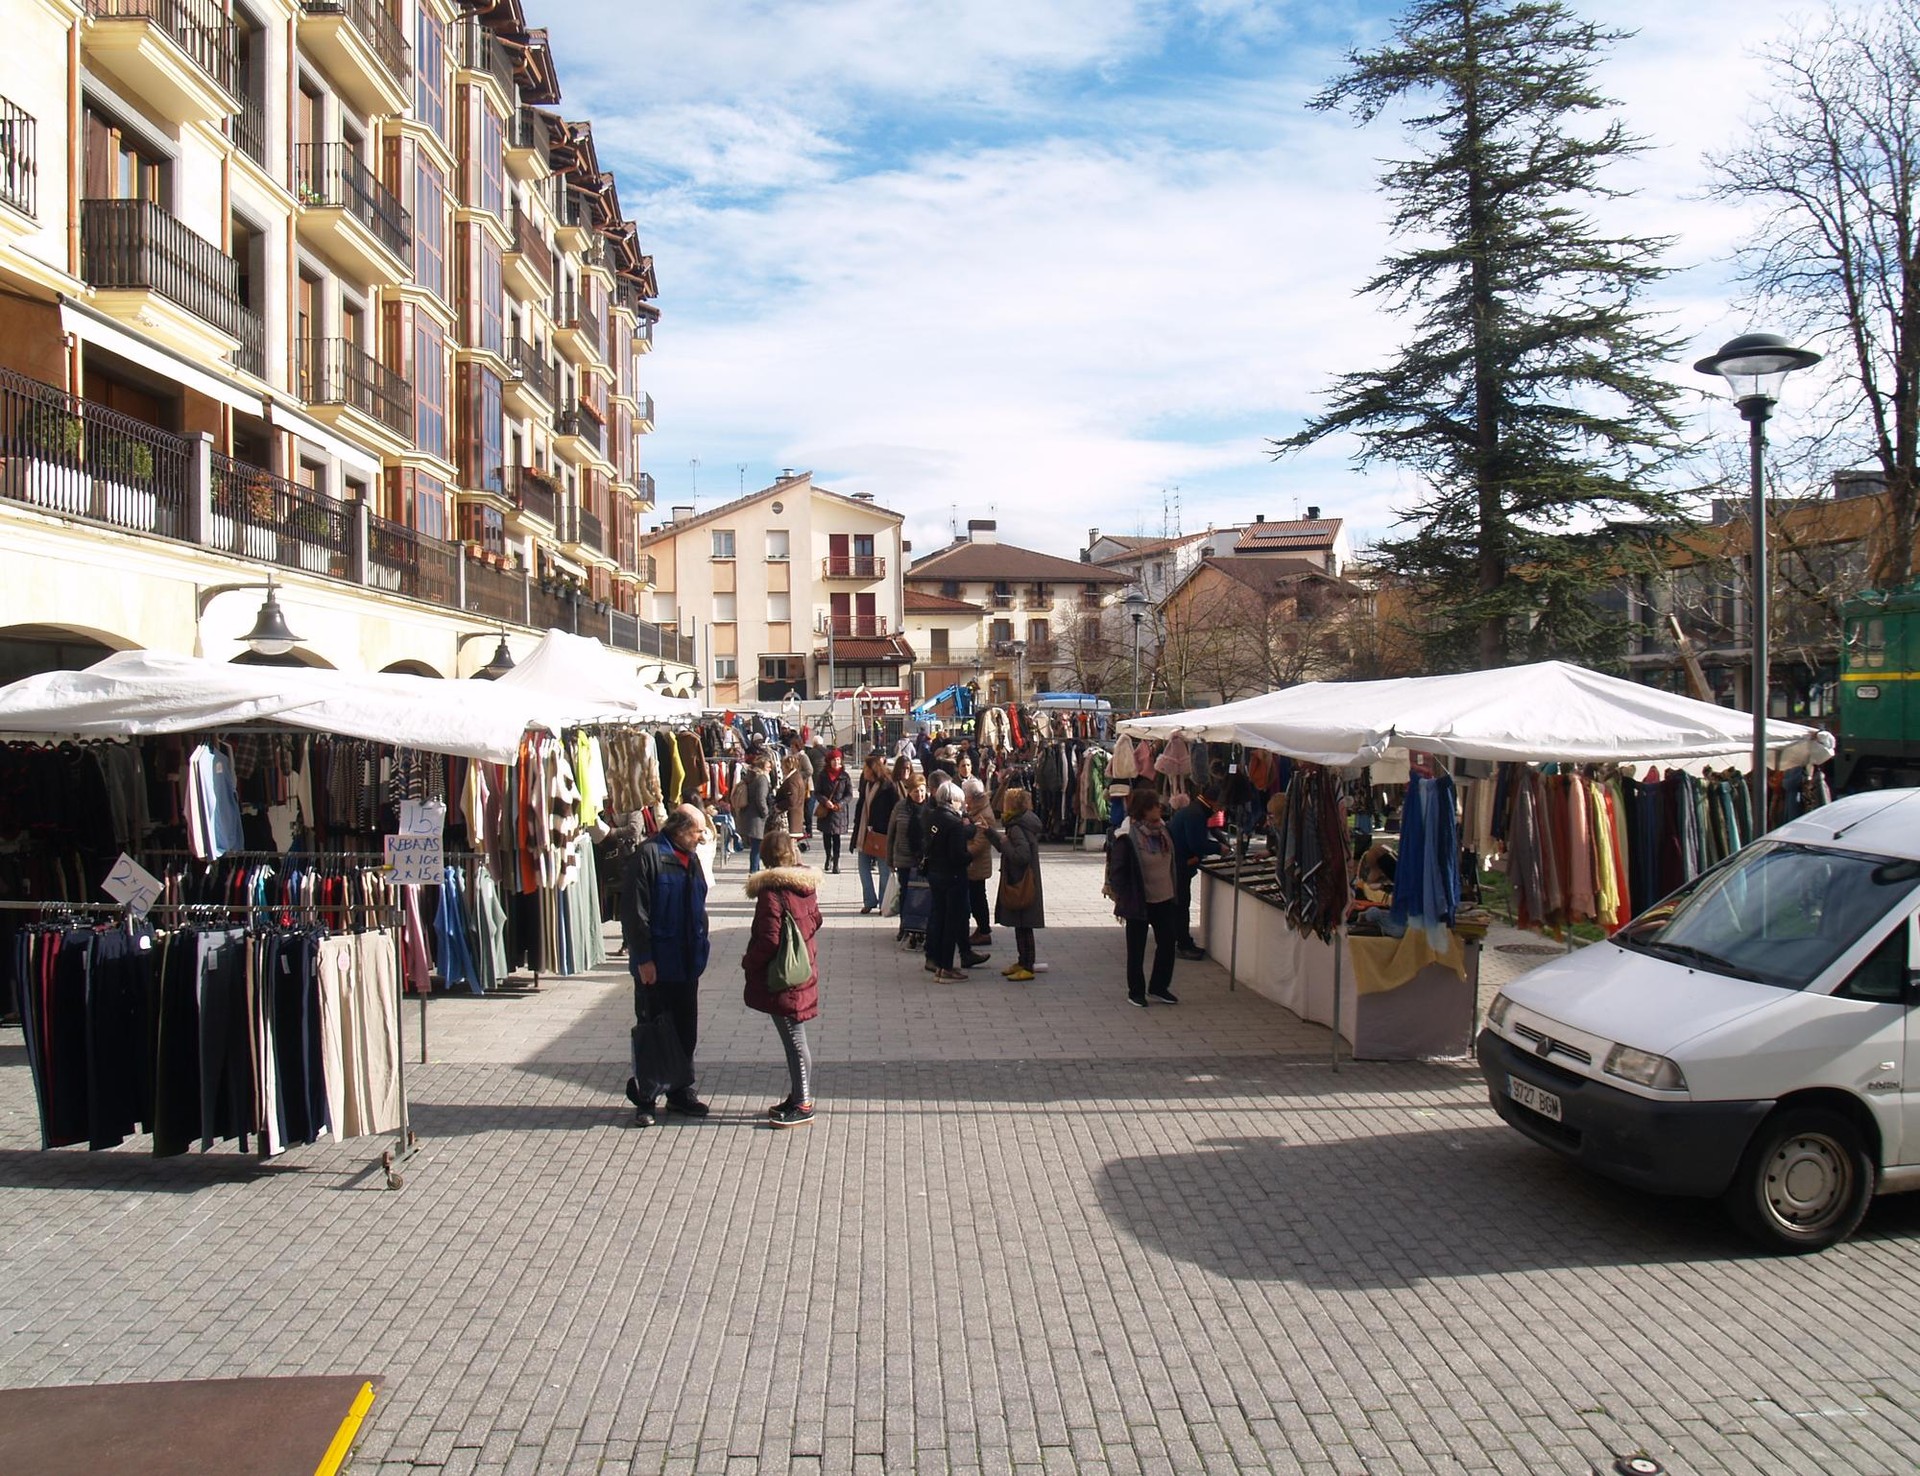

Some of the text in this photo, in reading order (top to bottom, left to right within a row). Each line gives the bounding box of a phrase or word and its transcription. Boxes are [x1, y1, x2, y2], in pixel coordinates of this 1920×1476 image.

[388, 837, 440, 852] REBAJAS
[419, 854, 440, 865] 10€
[111, 860, 132, 887] 2
[391, 869, 403, 882] 2
[418, 867, 441, 882] 15€
[1513, 1080, 1558, 1116] 9727 BGM
